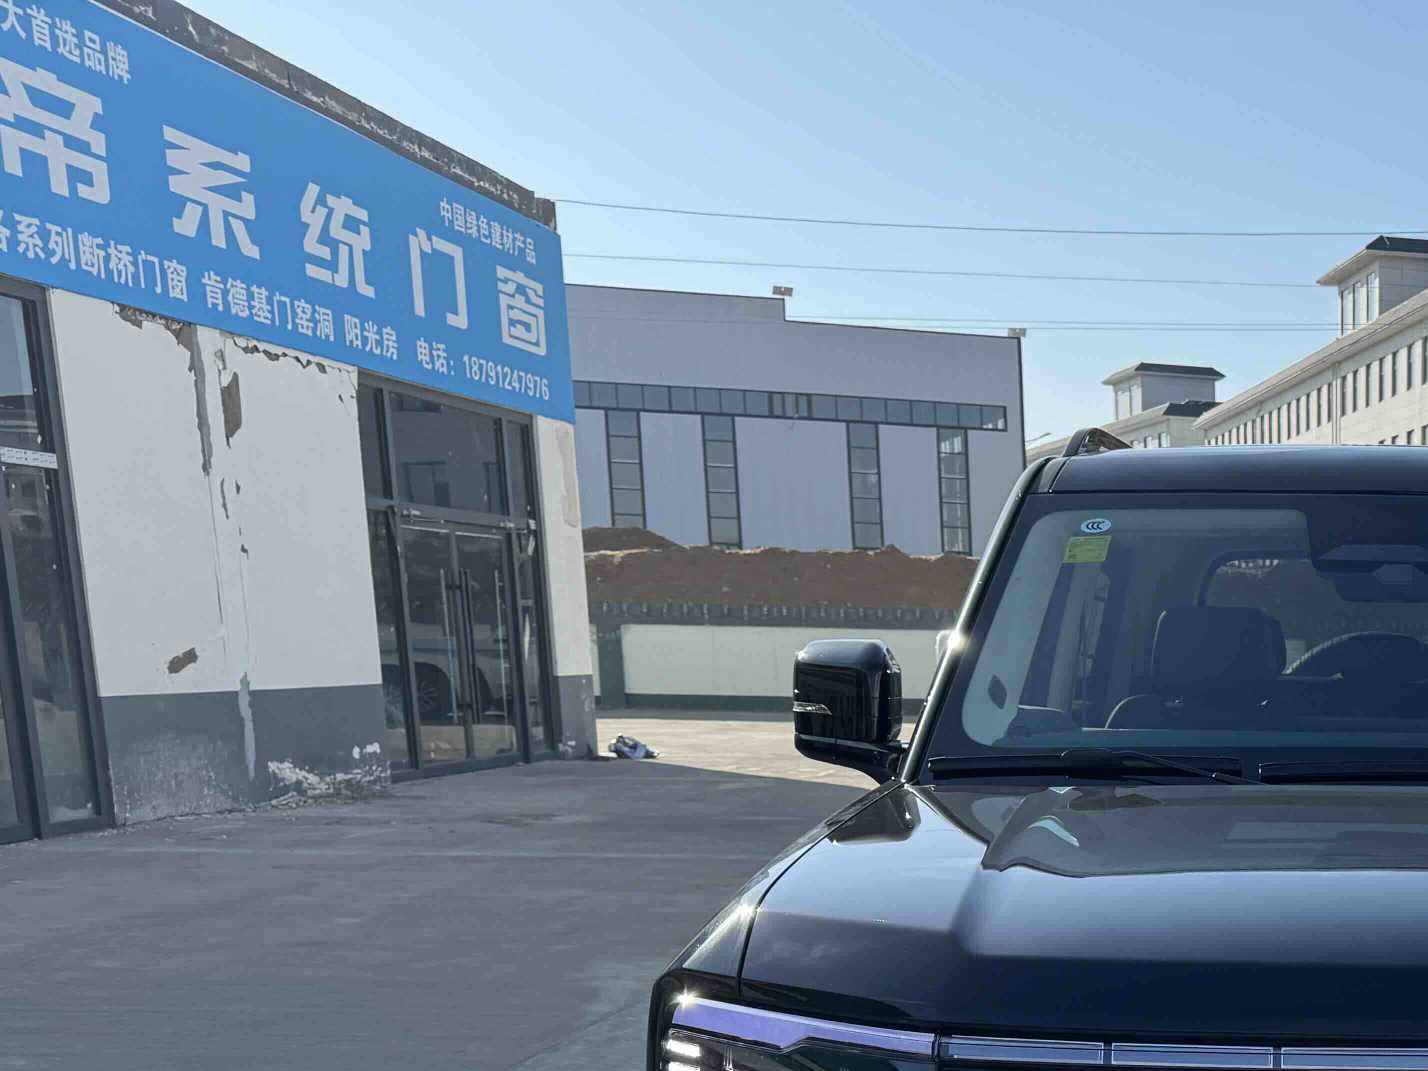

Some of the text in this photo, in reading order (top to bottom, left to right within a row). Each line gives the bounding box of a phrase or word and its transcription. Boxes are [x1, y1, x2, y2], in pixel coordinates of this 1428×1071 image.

[439, 197, 536, 265] 中国绿色建材产品
[201, 271, 335, 342] 肯德基门窑洞
[343, 313, 399, 361] 阳光房
[463, 354, 550, 401] 18791247976
